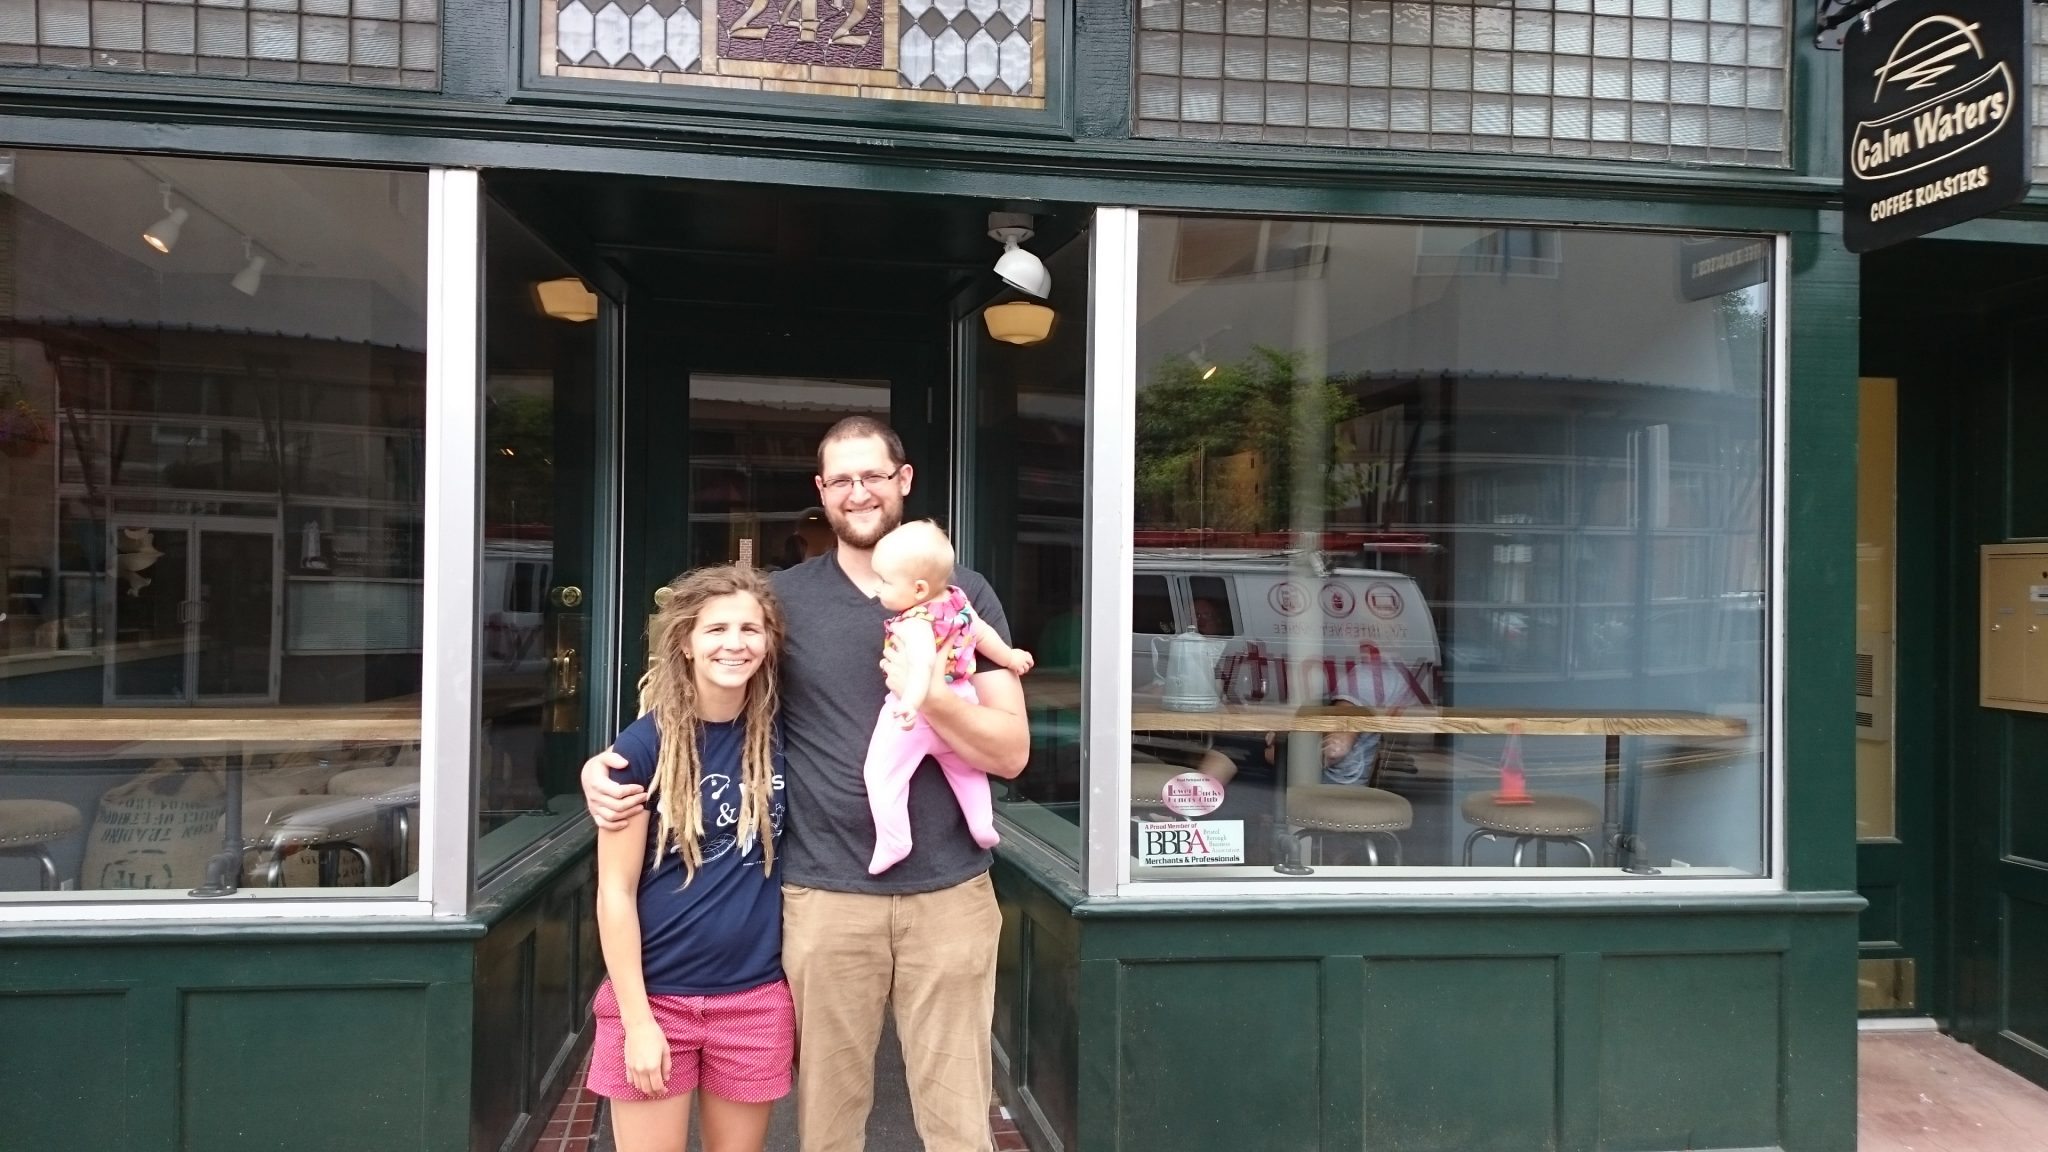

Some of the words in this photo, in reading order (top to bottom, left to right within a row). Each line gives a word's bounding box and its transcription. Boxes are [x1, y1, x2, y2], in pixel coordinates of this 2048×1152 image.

[1857, 128, 1911, 172] Calm
[1913, 91, 2005, 149] Waters
[1870, 188, 1914, 222] COFFEE
[1915, 165, 1989, 208] ROASTERS
[1168, 785, 1191, 796] Lower
[1193, 786, 1221, 796] Bucks
[716, 802, 738, 827] &
[1145, 829, 1210, 855] BBBA
[1191, 855, 1240, 863] Professionals
